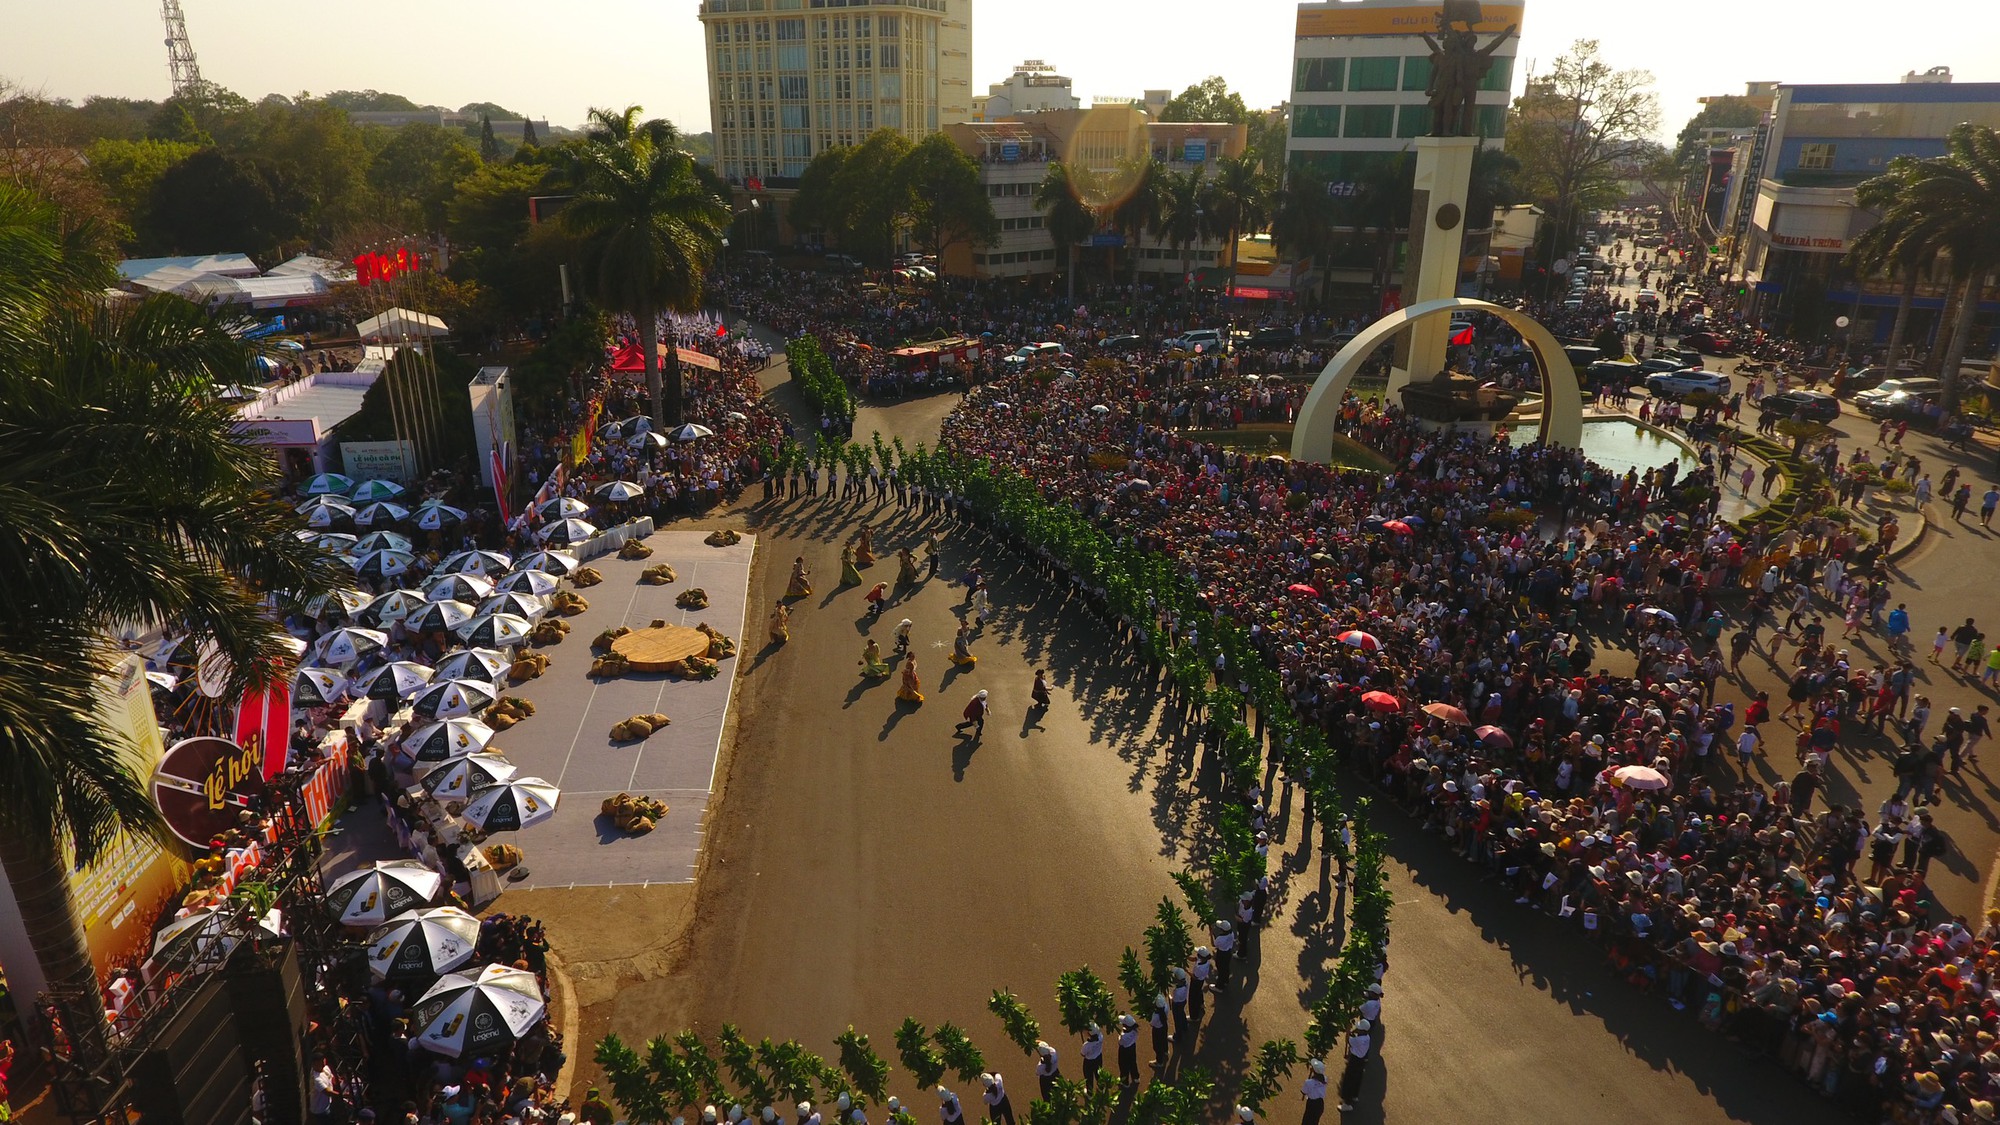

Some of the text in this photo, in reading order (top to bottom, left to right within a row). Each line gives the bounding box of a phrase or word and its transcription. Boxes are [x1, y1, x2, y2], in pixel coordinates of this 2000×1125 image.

[203, 733, 261, 811] Lễ hội
[389, 896, 414, 911] Legend
[398, 960, 424, 970] Legend
[472, 1028, 501, 1042] Legend
